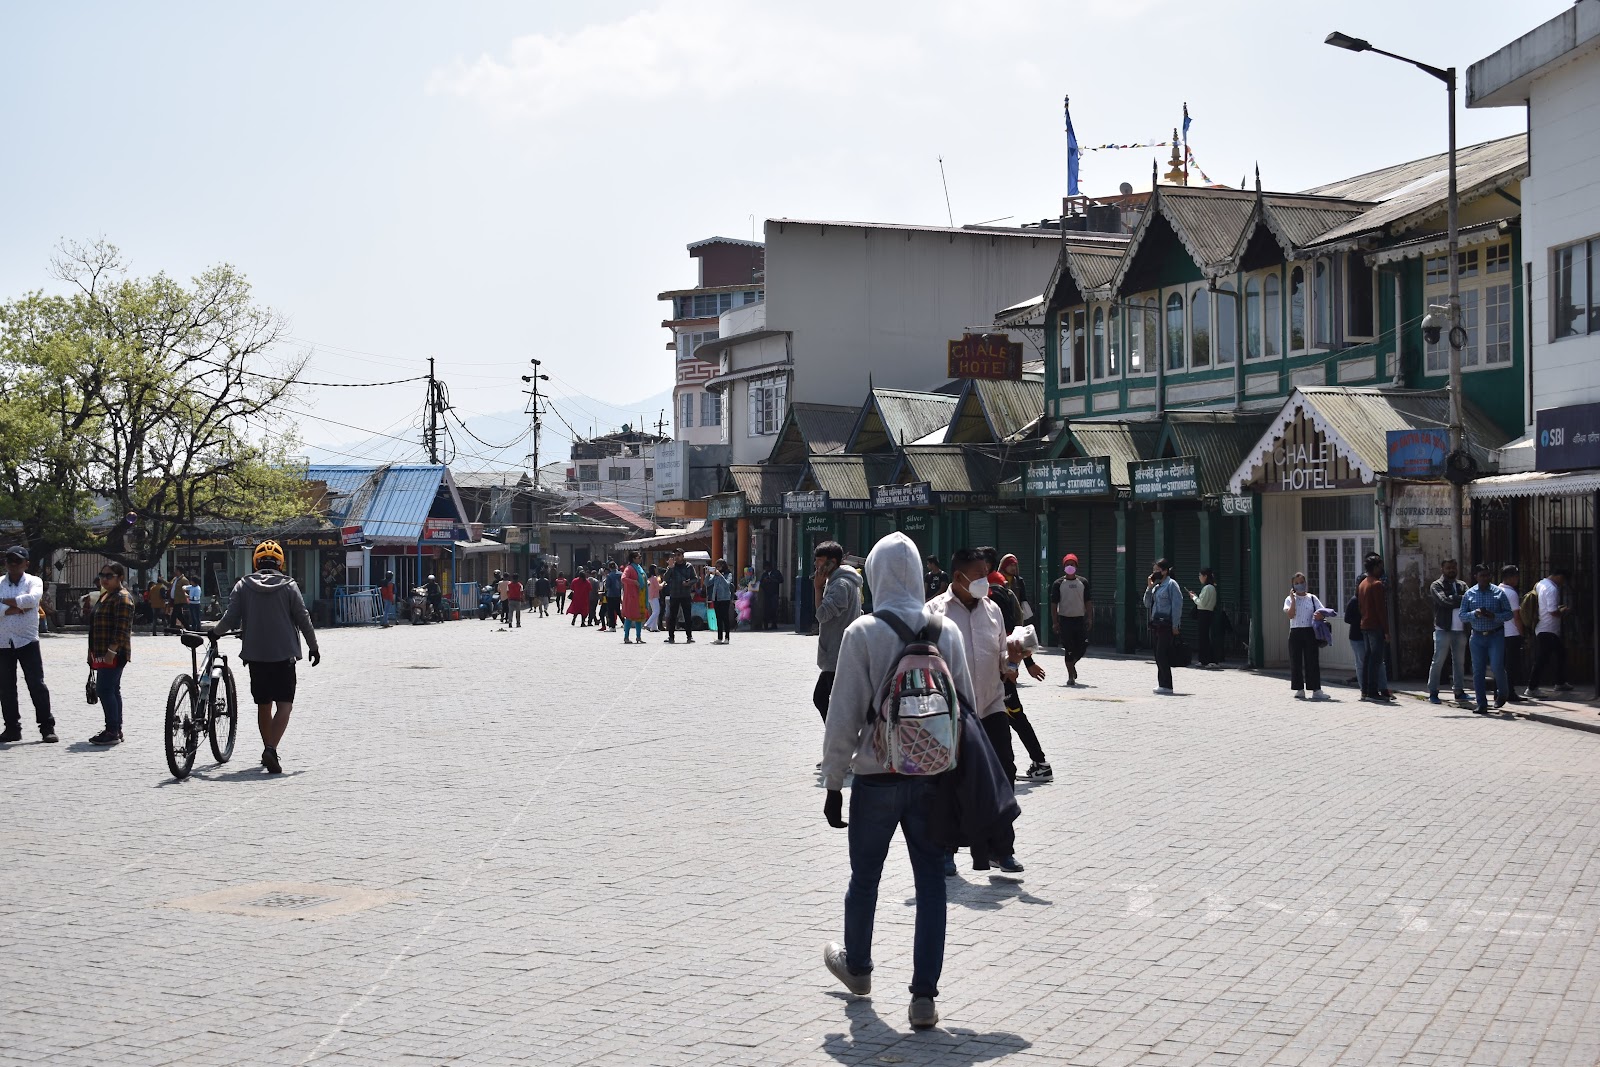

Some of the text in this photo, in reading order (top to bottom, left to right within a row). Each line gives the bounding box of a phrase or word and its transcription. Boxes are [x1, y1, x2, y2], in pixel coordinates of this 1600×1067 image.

[1549, 427, 1564, 447] SBI
[1026, 481, 1044, 490] OXFORD
[1045, 481, 1058, 490] BOOK
[1067, 478, 1096, 489] STATIONERY
[1282, 468, 1336, 491] HOTEL
[1134, 484, 1151, 494] OXFORD
[1151, 482, 1162, 493] BOOK
[1166, 480, 1191, 491] STATIONERY
[940, 493, 966, 503] WOOD
[832, 501, 864, 509] HIMALAYAN
[1395, 507, 1434, 516] CHOWRASTA
